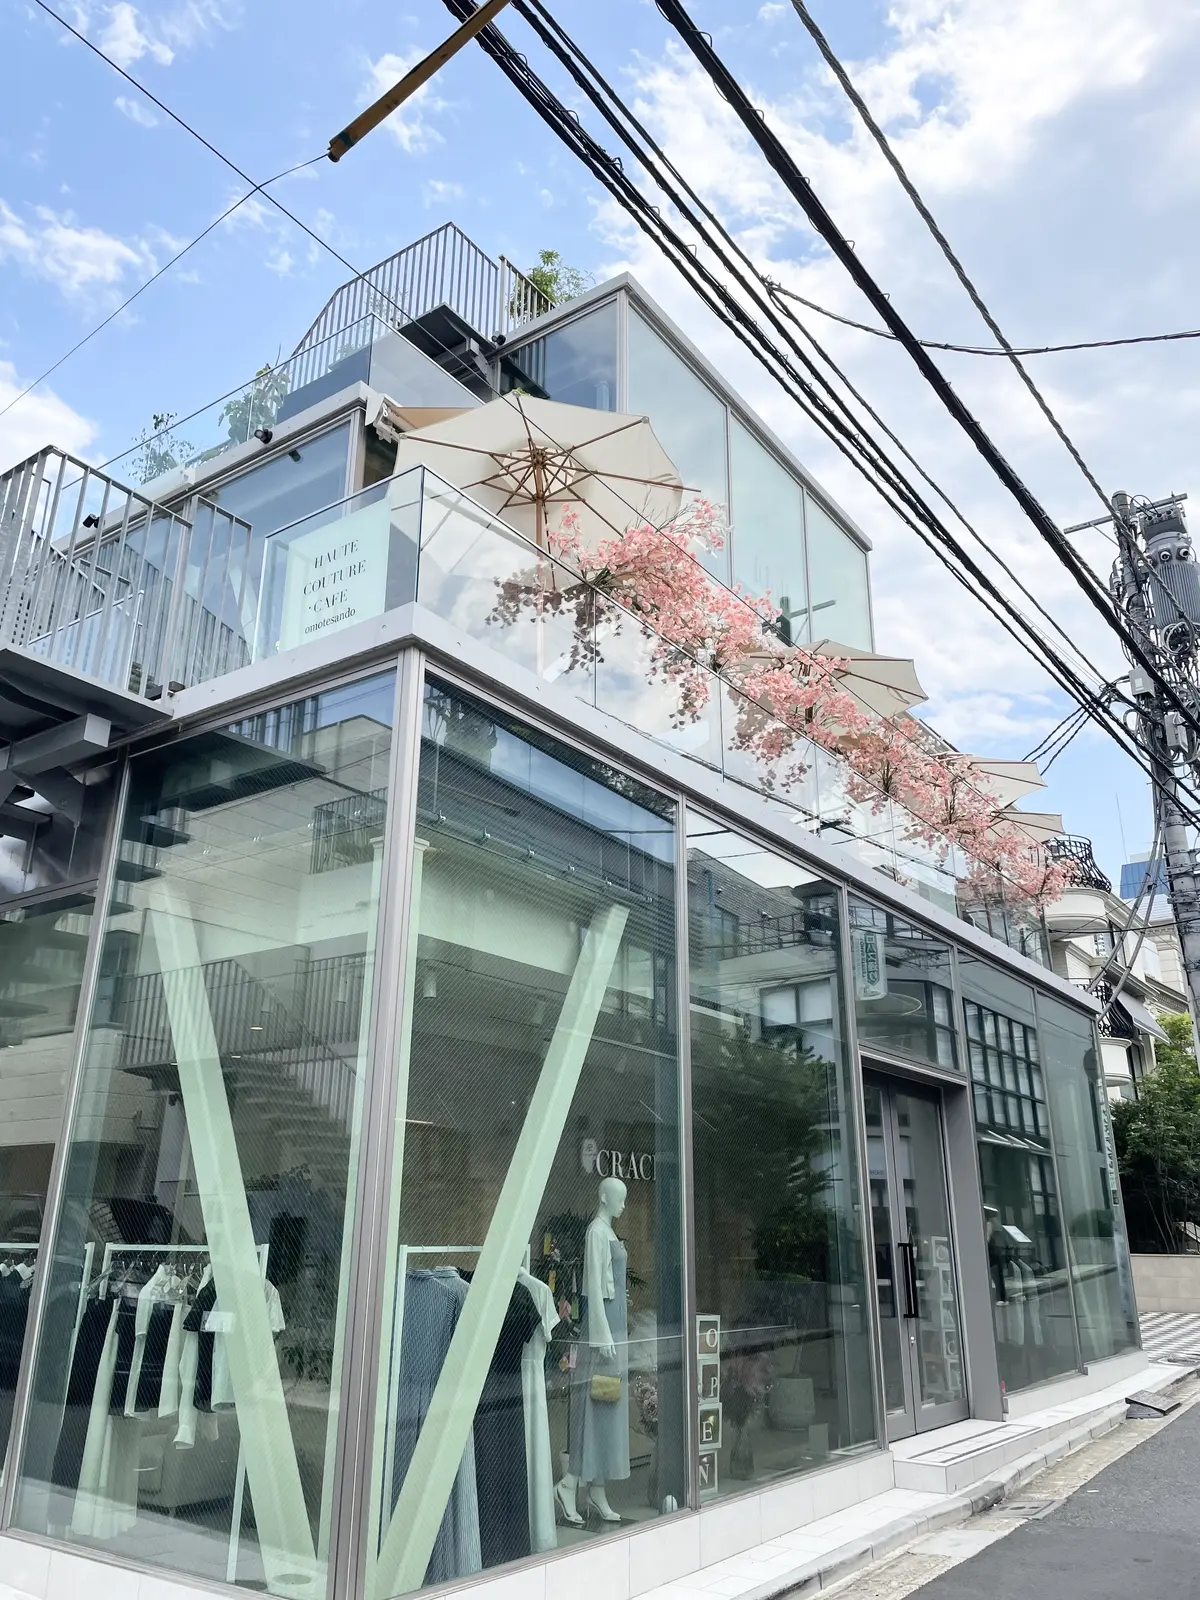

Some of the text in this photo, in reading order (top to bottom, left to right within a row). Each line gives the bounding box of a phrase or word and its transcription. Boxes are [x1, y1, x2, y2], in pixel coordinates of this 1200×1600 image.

[313, 539, 359, 569] HAUTE
[303, 559, 367, 596] COUTURE
[304, 607, 356, 634] omotesando
